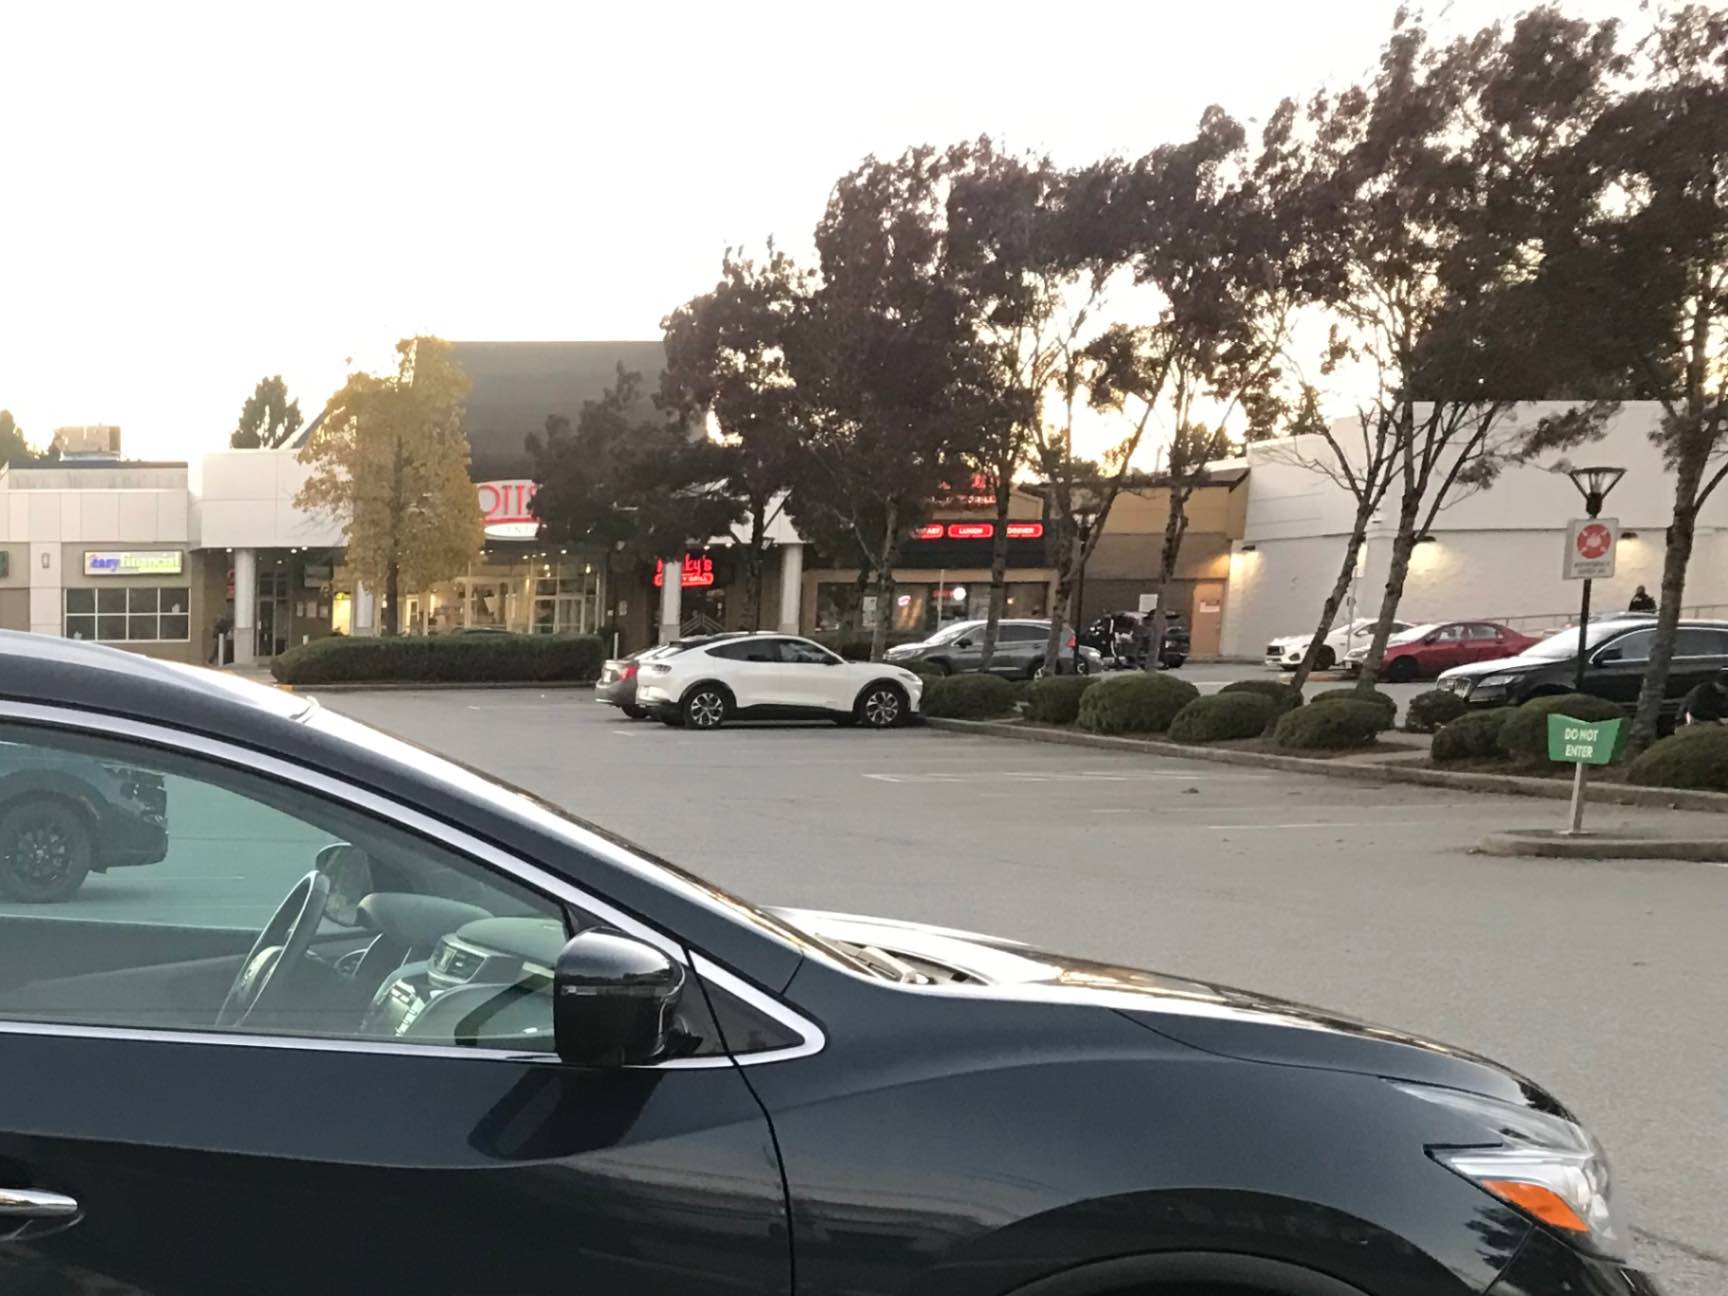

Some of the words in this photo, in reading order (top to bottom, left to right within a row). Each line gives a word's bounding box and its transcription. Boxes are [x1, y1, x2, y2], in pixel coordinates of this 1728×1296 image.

[90, 558, 120, 573] easy
[1564, 728, 1579, 740] DO
[1579, 729, 1599, 742] NOT
[1565, 744, 1594, 758] ENTER
